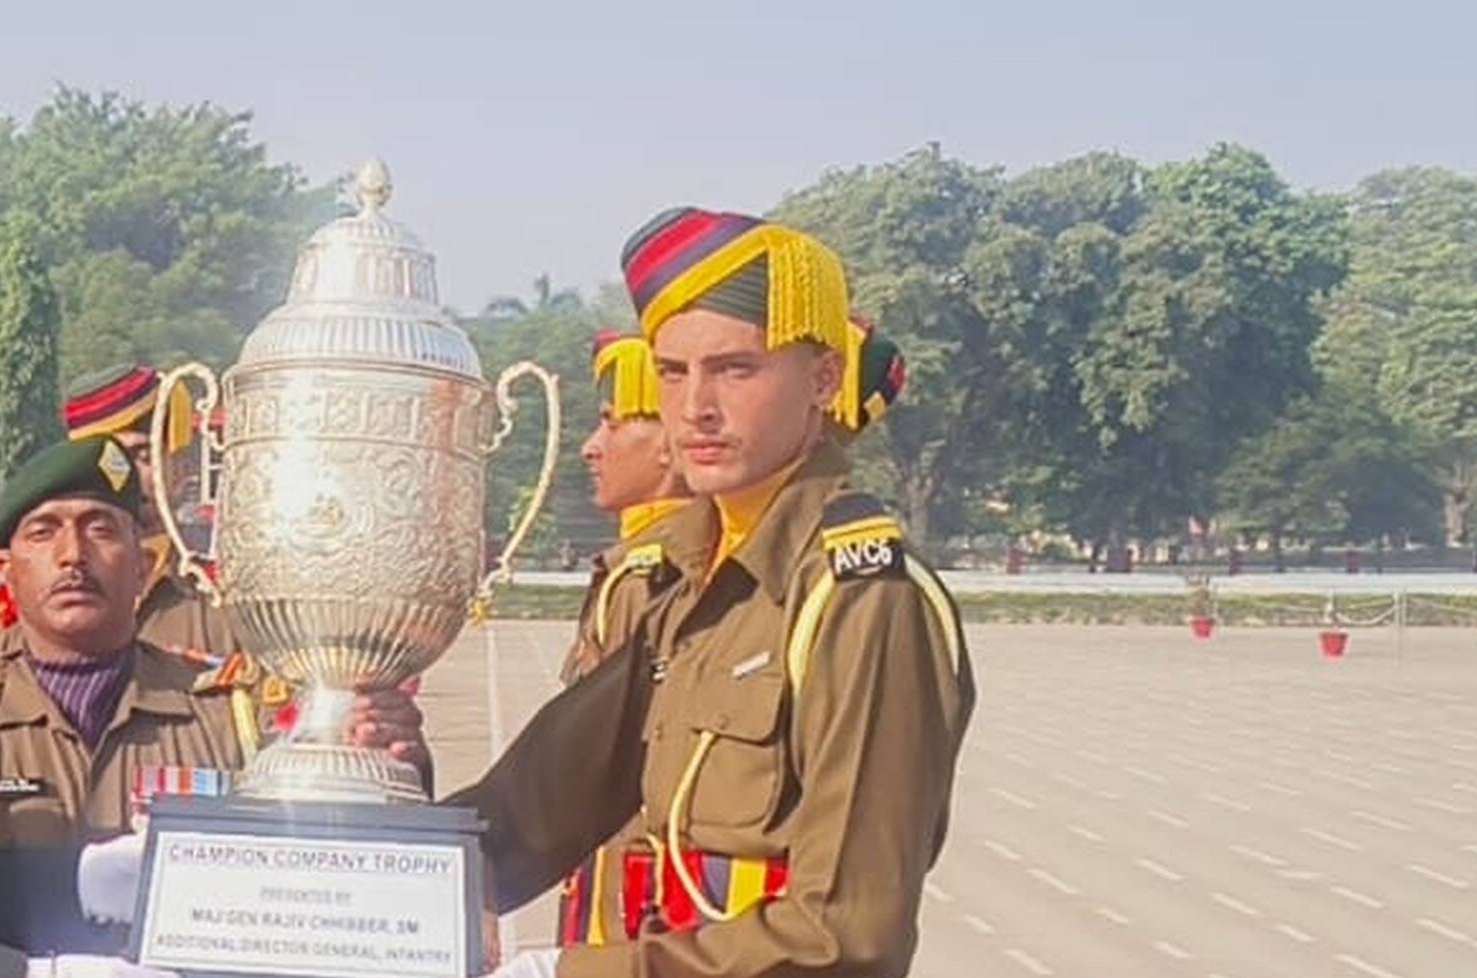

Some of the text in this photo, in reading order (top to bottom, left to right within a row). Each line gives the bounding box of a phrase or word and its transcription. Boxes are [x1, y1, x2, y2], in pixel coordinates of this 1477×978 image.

[169, 843, 451, 875] CHAMPION COMPANY TROPHY
[191, 908, 223, 924] MAJ
[225, 908, 258, 926] GEN
[262, 911, 305, 929] RAJIV
[155, 933, 236, 952] ADDITIONAL
[240, 938, 309, 955] DIRECTOR
[384, 946, 452, 963] INFANTRY
